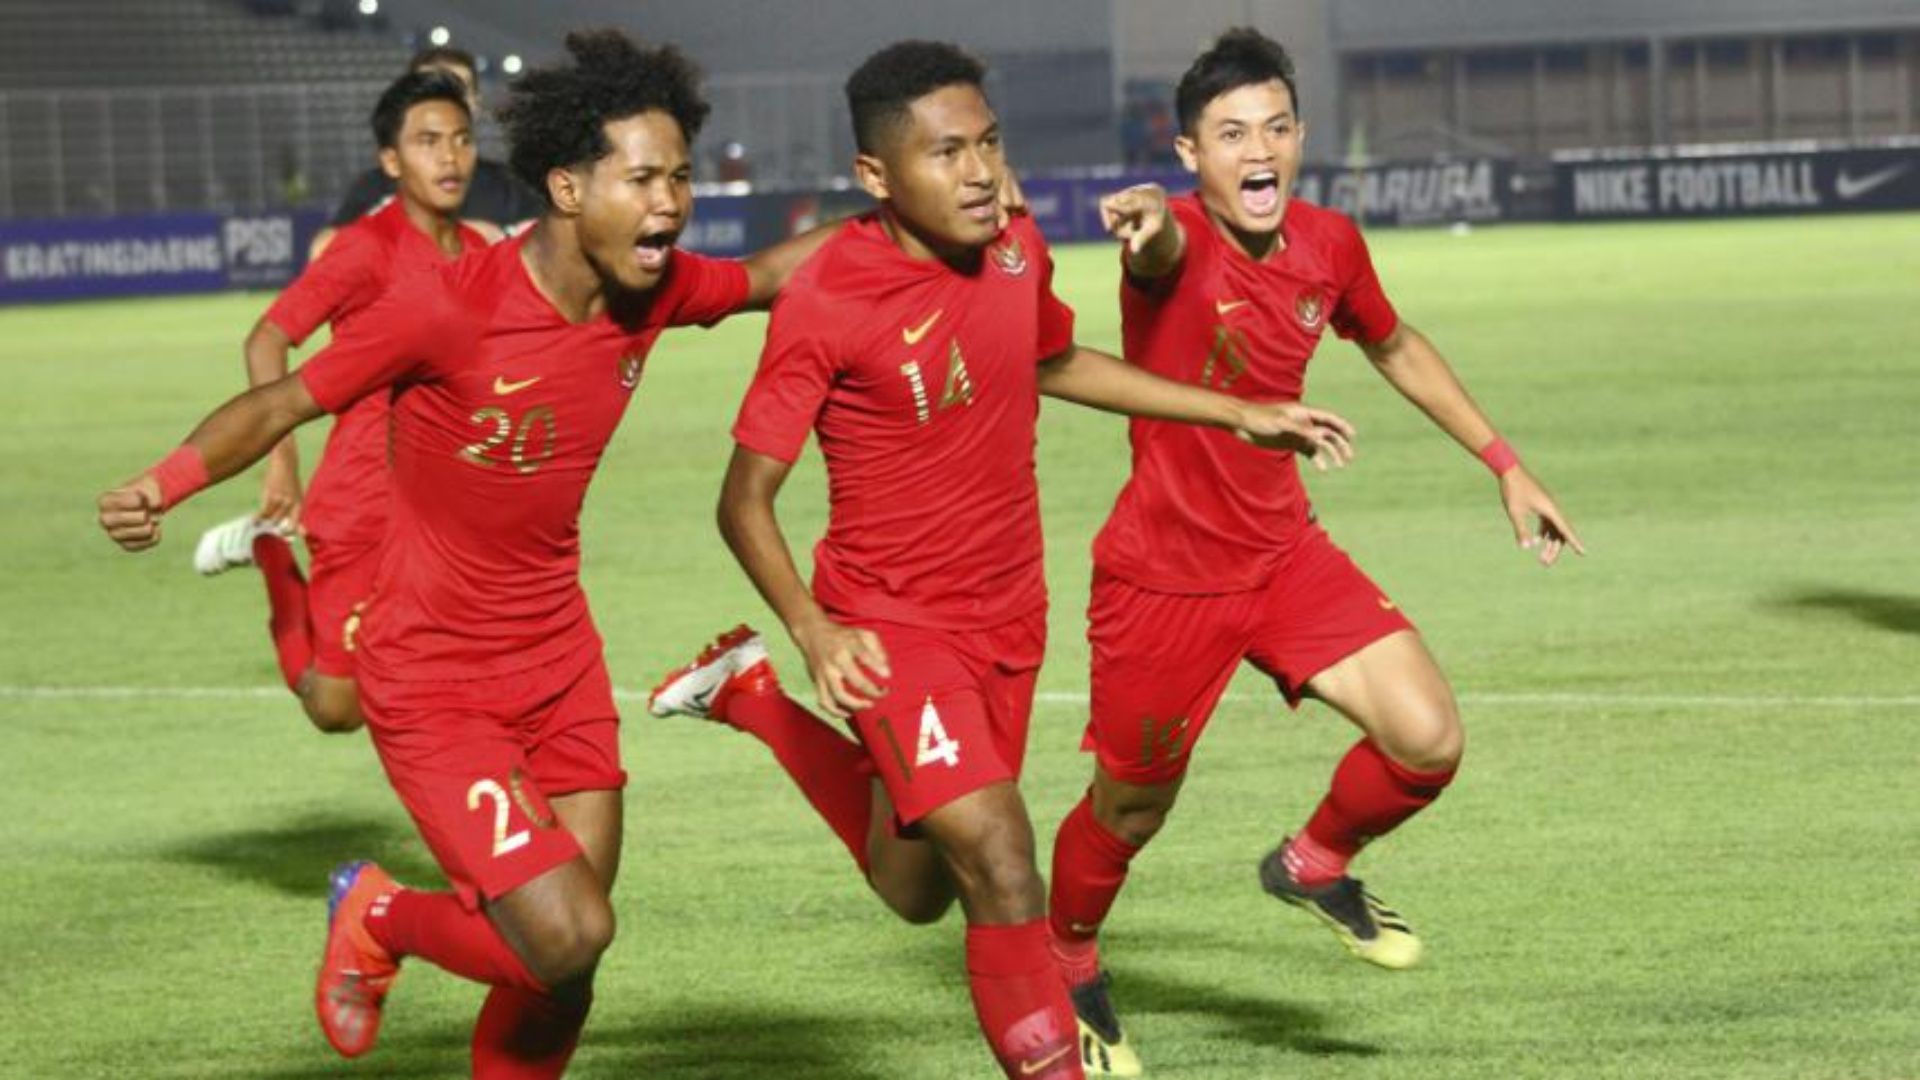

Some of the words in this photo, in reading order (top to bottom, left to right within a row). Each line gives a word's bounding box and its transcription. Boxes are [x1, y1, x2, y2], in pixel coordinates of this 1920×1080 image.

[1574, 166, 1648, 213] NIKE
[1658, 160, 1818, 209] FOOTBALL
[224, 217, 293, 265] PSSI
[900, 336, 975, 424] 14
[459, 404, 557, 475] 20
[879, 694, 960, 784] 14
